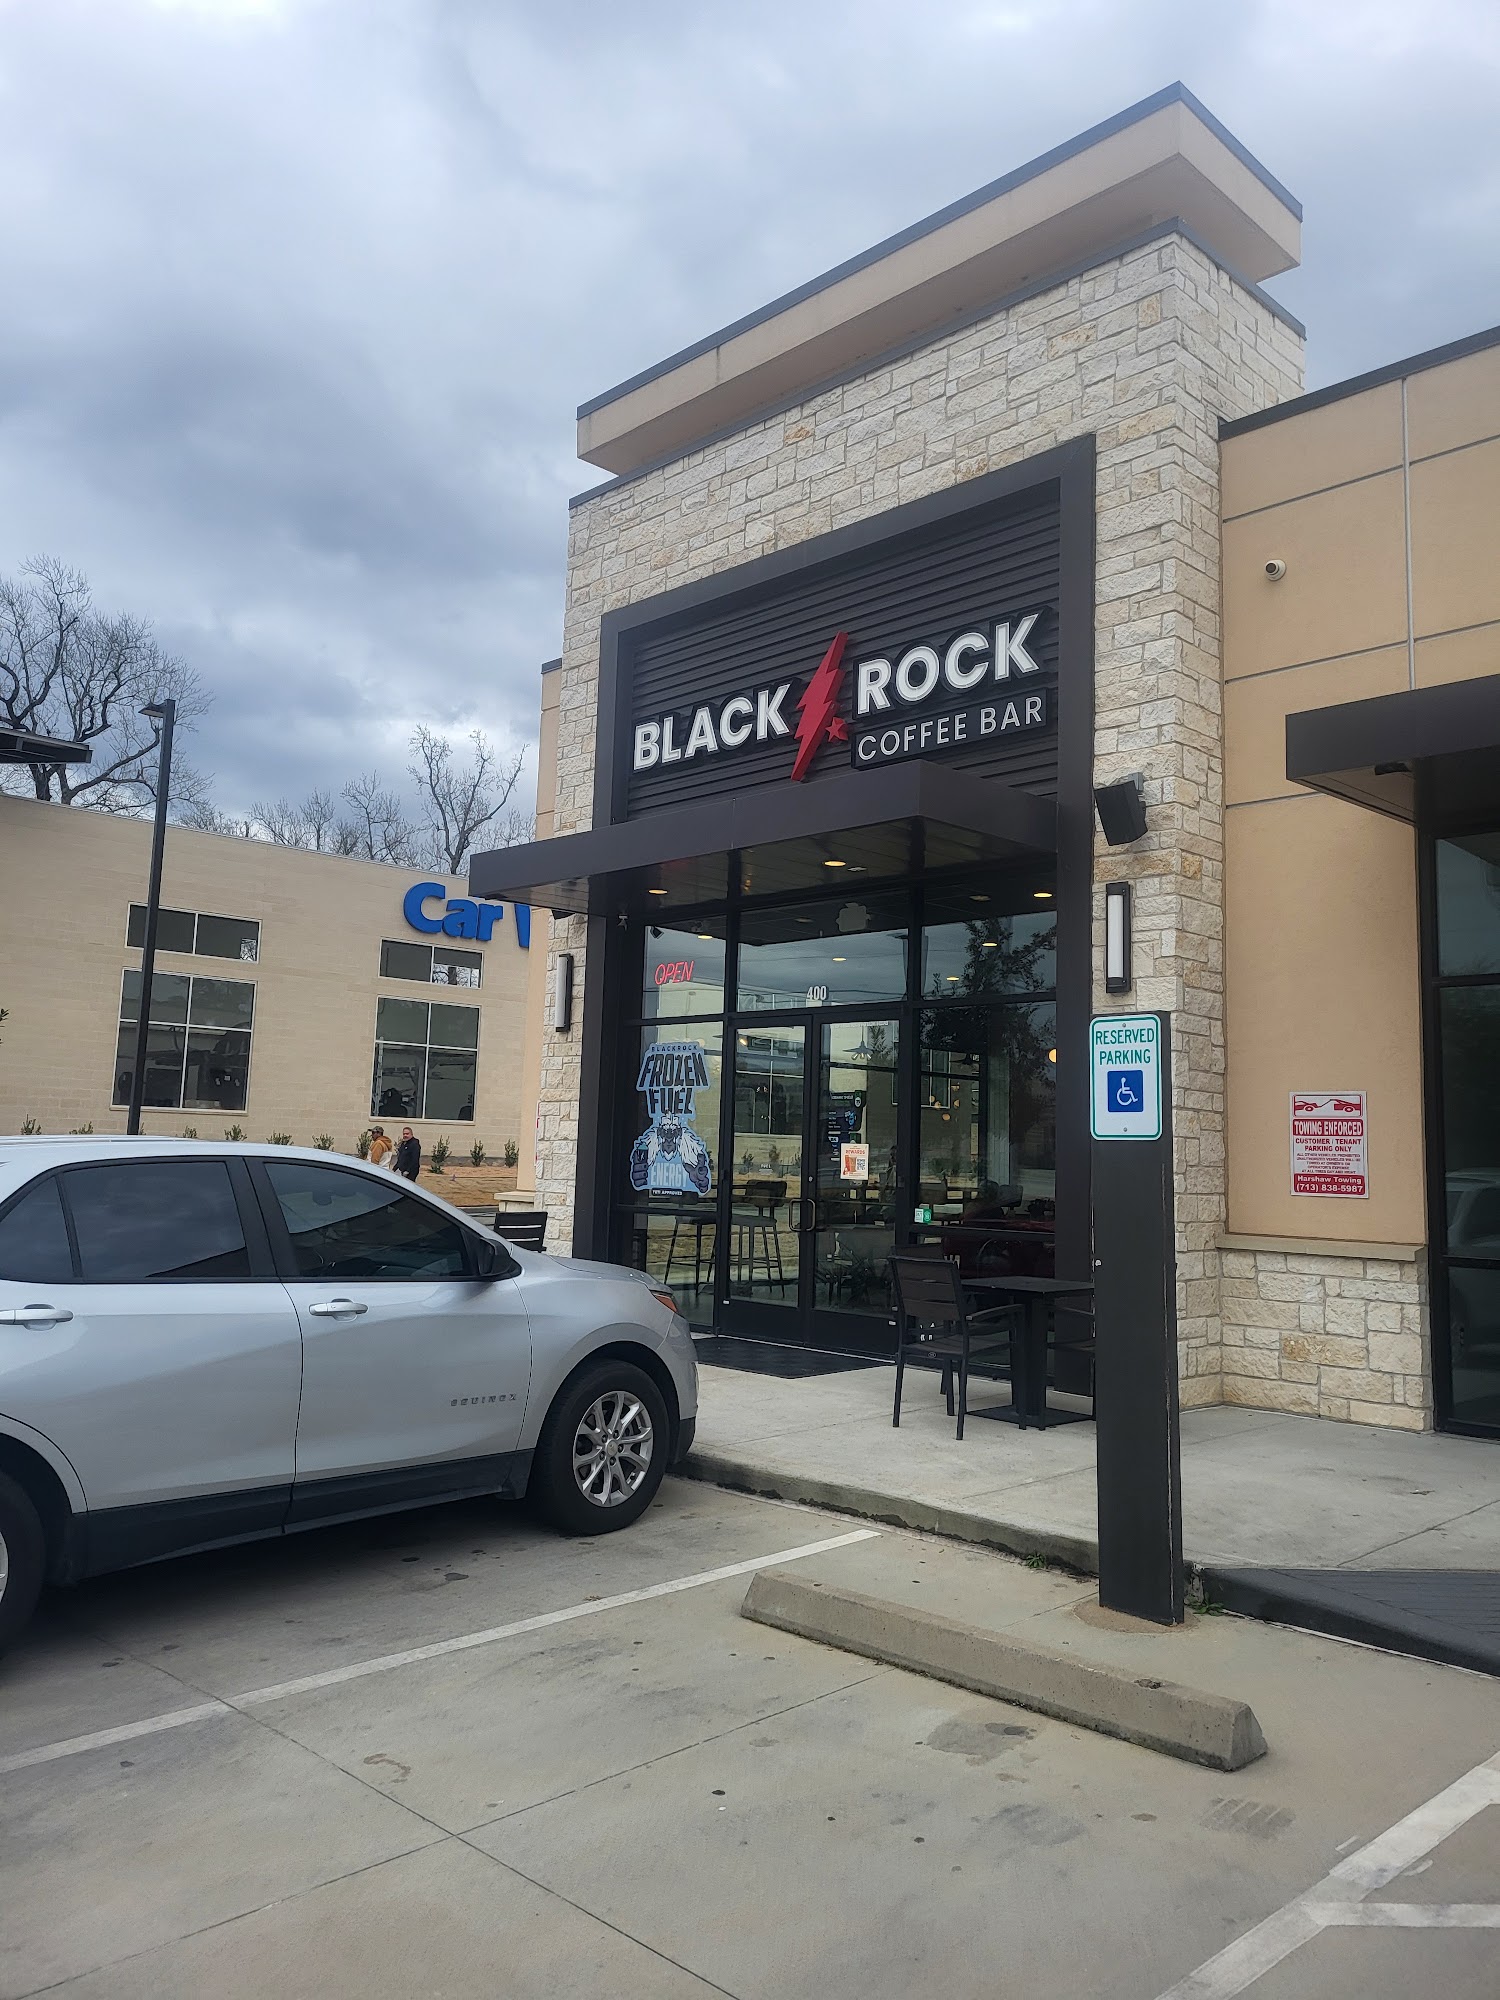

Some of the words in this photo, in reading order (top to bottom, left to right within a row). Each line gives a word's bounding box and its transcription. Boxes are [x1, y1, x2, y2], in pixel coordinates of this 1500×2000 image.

[633, 683, 793, 771] BLACK
[857, 613, 1040, 715] ROCK
[858, 712, 968, 761] COFFEE
[980, 696, 1043, 735] BAR
[403, 881, 503, 941] Car
[654, 961, 695, 985] OPEN
[806, 986, 827, 1000] 400
[1096, 1028, 1154, 1045] RESERVED
[1100, 1048, 1151, 1065] PARKING
[639, 1052, 709, 1087] FROZEN
[649, 1087, 693, 1114] FUEL
[1294, 1121, 1321, 1135] TOWING
[1324, 1122, 1362, 1135] ENFORCED
[650, 1162, 688, 1188] ENERGY
[1334, 1176, 1362, 1184] Towing
[1296, 1183, 1318, 1192] (713)
[1321, 1184, 1363, 1193] 838-5987
